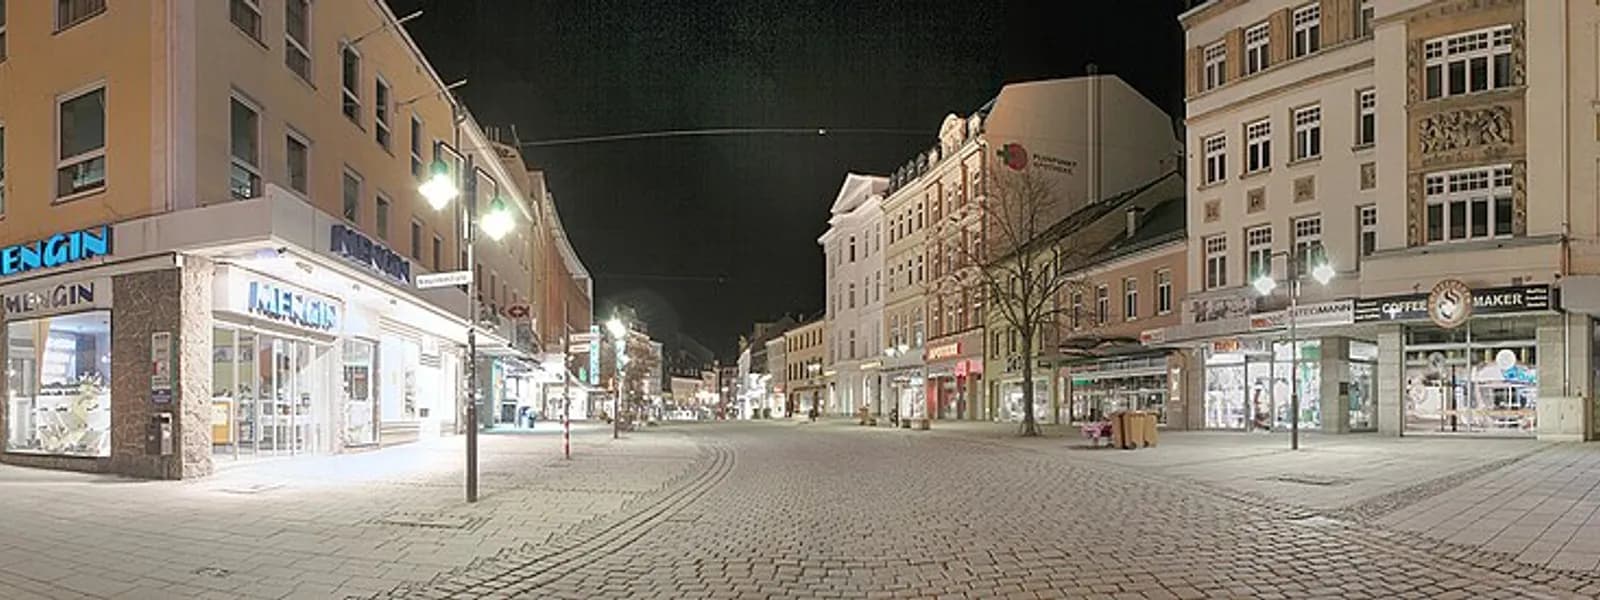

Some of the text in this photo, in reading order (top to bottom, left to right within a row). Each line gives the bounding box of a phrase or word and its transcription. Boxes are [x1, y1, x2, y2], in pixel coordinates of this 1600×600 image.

[6, 282, 94, 313] MENGIN
[1382, 299, 1427, 314] COFFEE
[1473, 293, 1523, 307] MAKER
